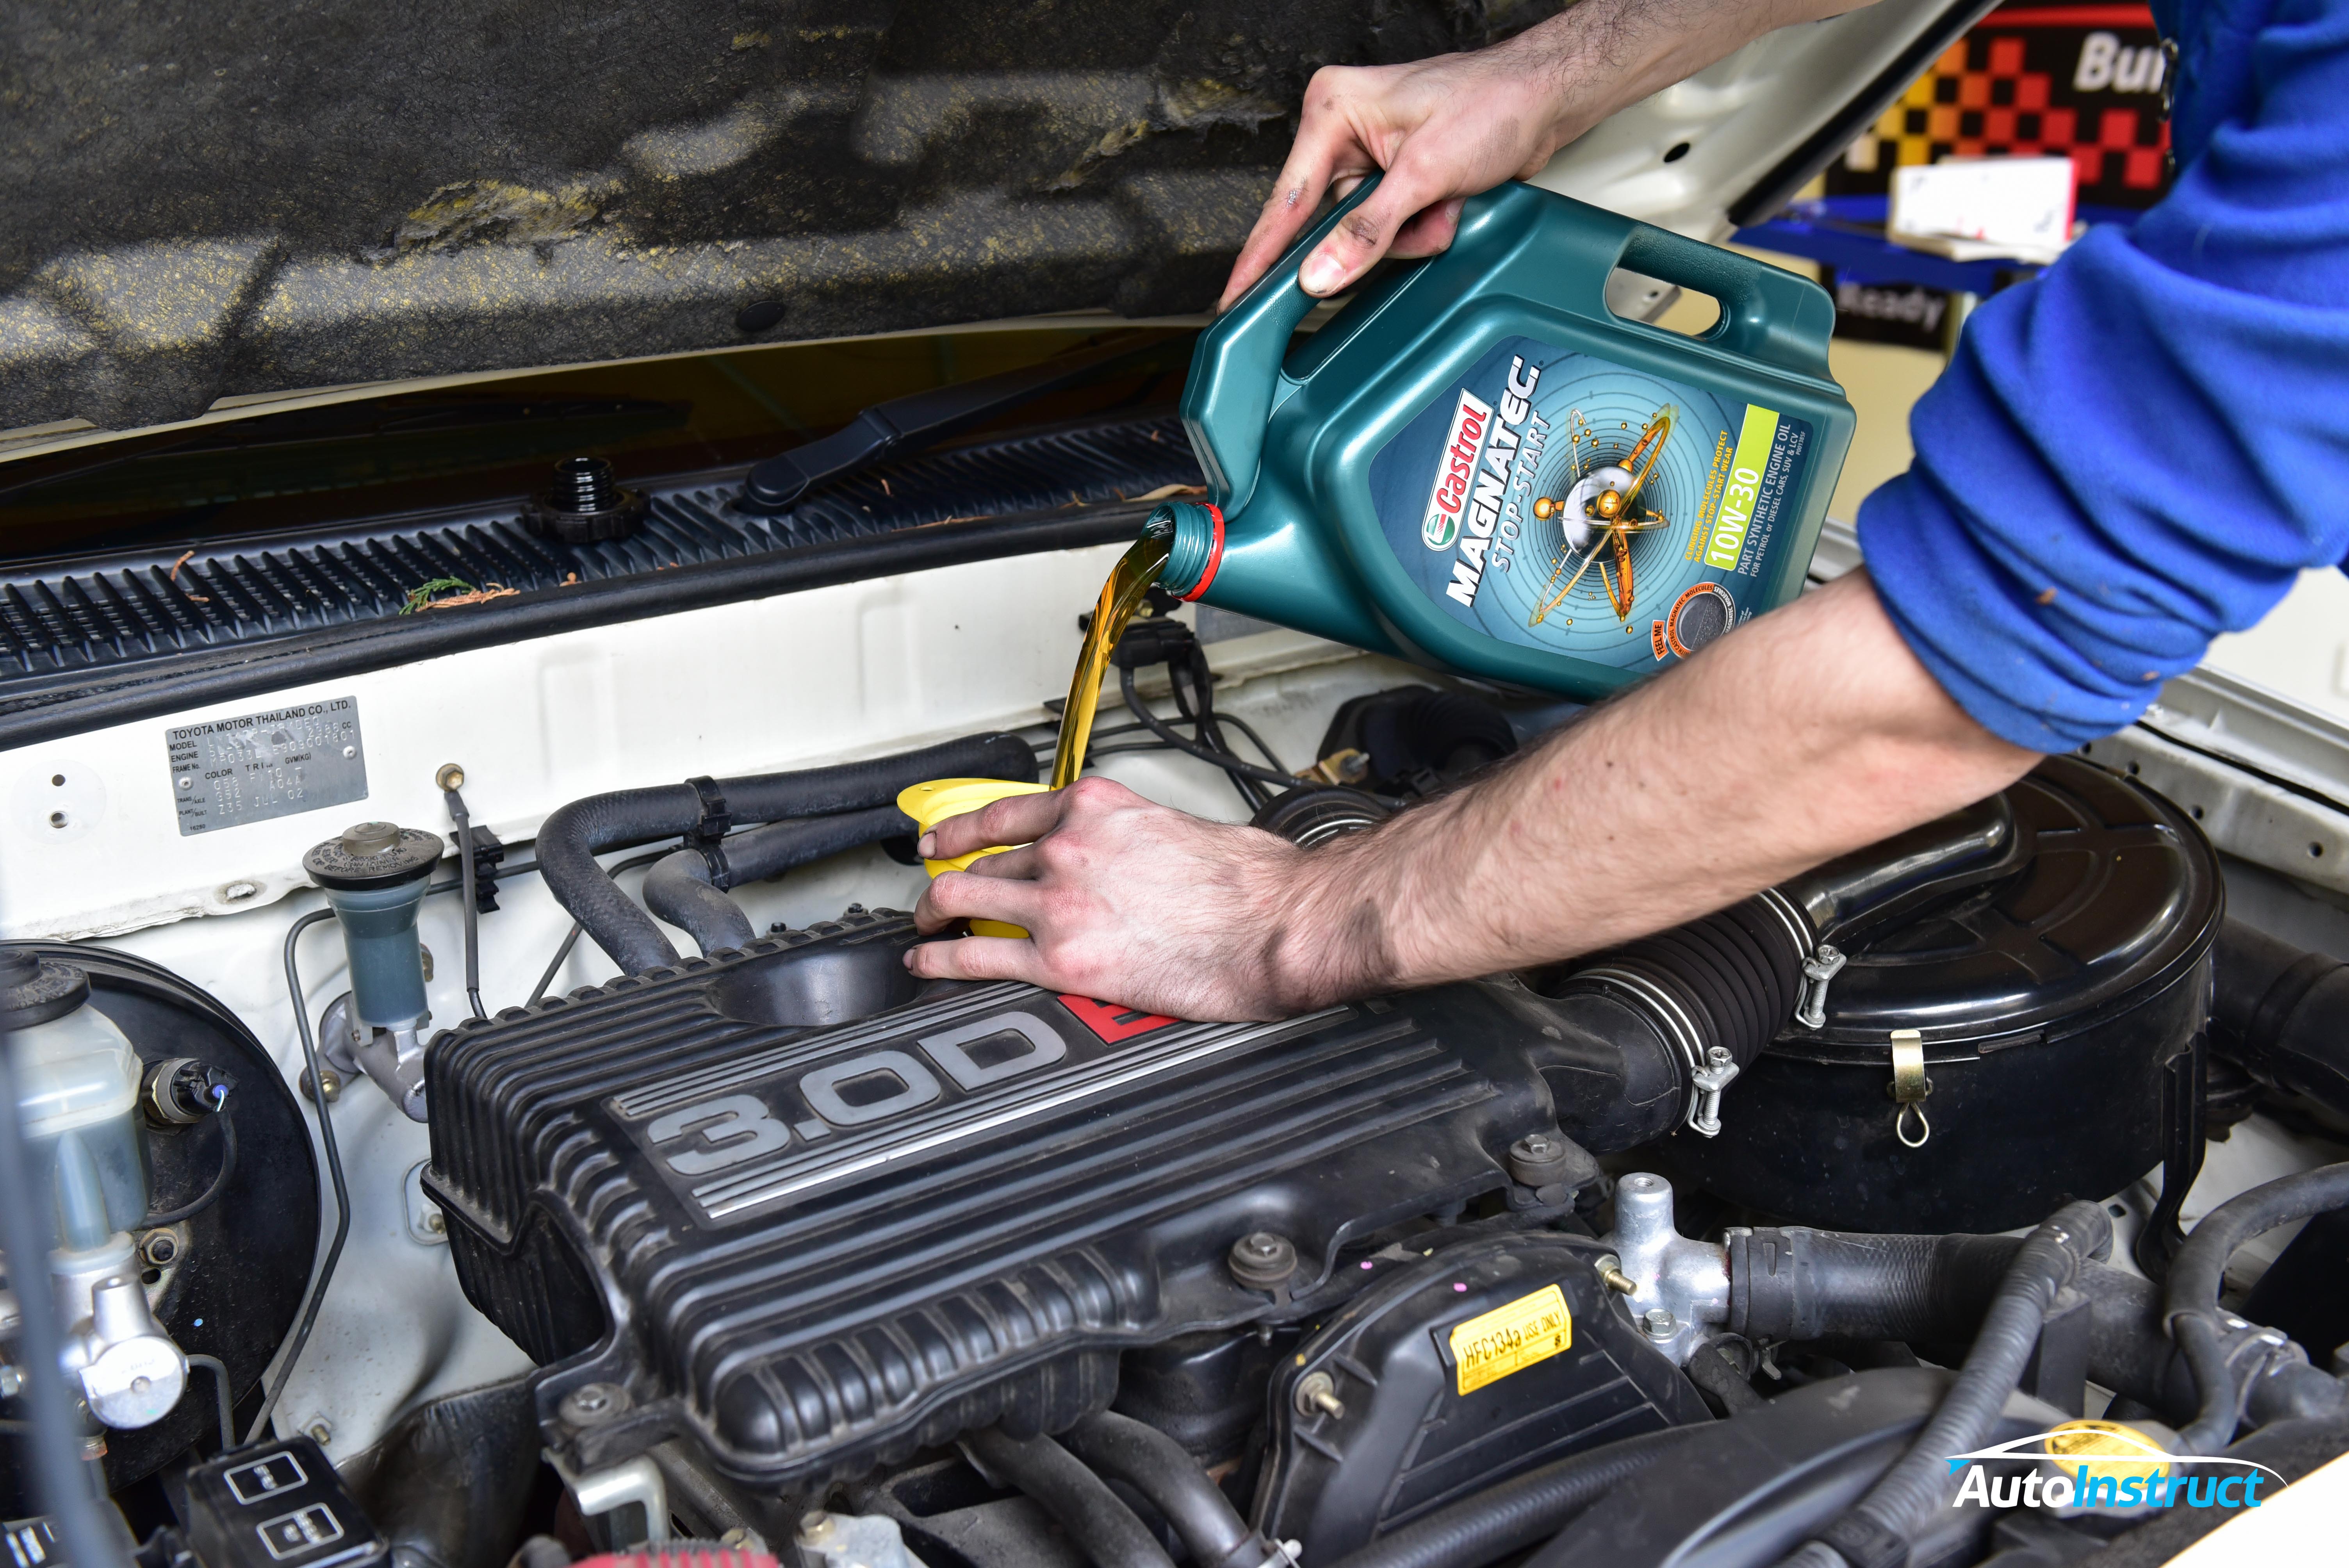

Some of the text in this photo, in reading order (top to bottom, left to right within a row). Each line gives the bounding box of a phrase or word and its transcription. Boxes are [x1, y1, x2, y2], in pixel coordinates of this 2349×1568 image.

[1790, 432, 1799, 448] LCV
[1796, 431, 1806, 456] P001385F
[1436, 404, 1487, 513] Castrol
[1782, 456, 1792, 472] SUV
[1446, 354, 1542, 608] MAGNATEC
[1492, 410, 1550, 573] STOP-START
[1776, 474, 1789, 495] CARS,
[1684, 429, 1728, 560] CLINGING MOLECULES PROTECT
[1693, 526, 1710, 563] AGAINST
[1720, 447, 1733, 472] WEAR
[1738, 424, 1791, 575] PART SYNTHETIC ENGINE OIL
[1711, 468, 1759, 561] 10W-30
[1768, 497, 1781, 522] DIESEL
[1767, 523, 1773, 532] or
[1756, 534, 1770, 561] PETROL
[1750, 561, 1761, 577] FOR
[1685, 584, 1713, 599] MOLECULES
[1714, 586, 1732, 606] MOLECULES
[1670, 597, 1685, 627] MAGNATEC
[1654, 624, 1665, 655] FEEL ME
[1670, 629, 1680, 650] CASTROL
[173, 700, 351, 740] TOYOTA MOTOR THAILAND CO., LTD.
[169, 740, 197, 751] MODEL
[171, 751, 199, 763] ENGINE
[172, 763, 191, 773] FRAME
[205, 768, 233, 779] COLOR
[285, 752, 311, 764] GVM(KG)
[218, 800, 242, 814] Z35
[288, 788, 303, 800] 02
[324, 864, 360, 873] BEFORE
[368, 856, 419, 873] REMOVING
[1463, 1327, 1521, 1368] HFC134a
[1523, 1320, 1538, 1340] USE
[1542, 1311, 1561, 1333] ONLY
